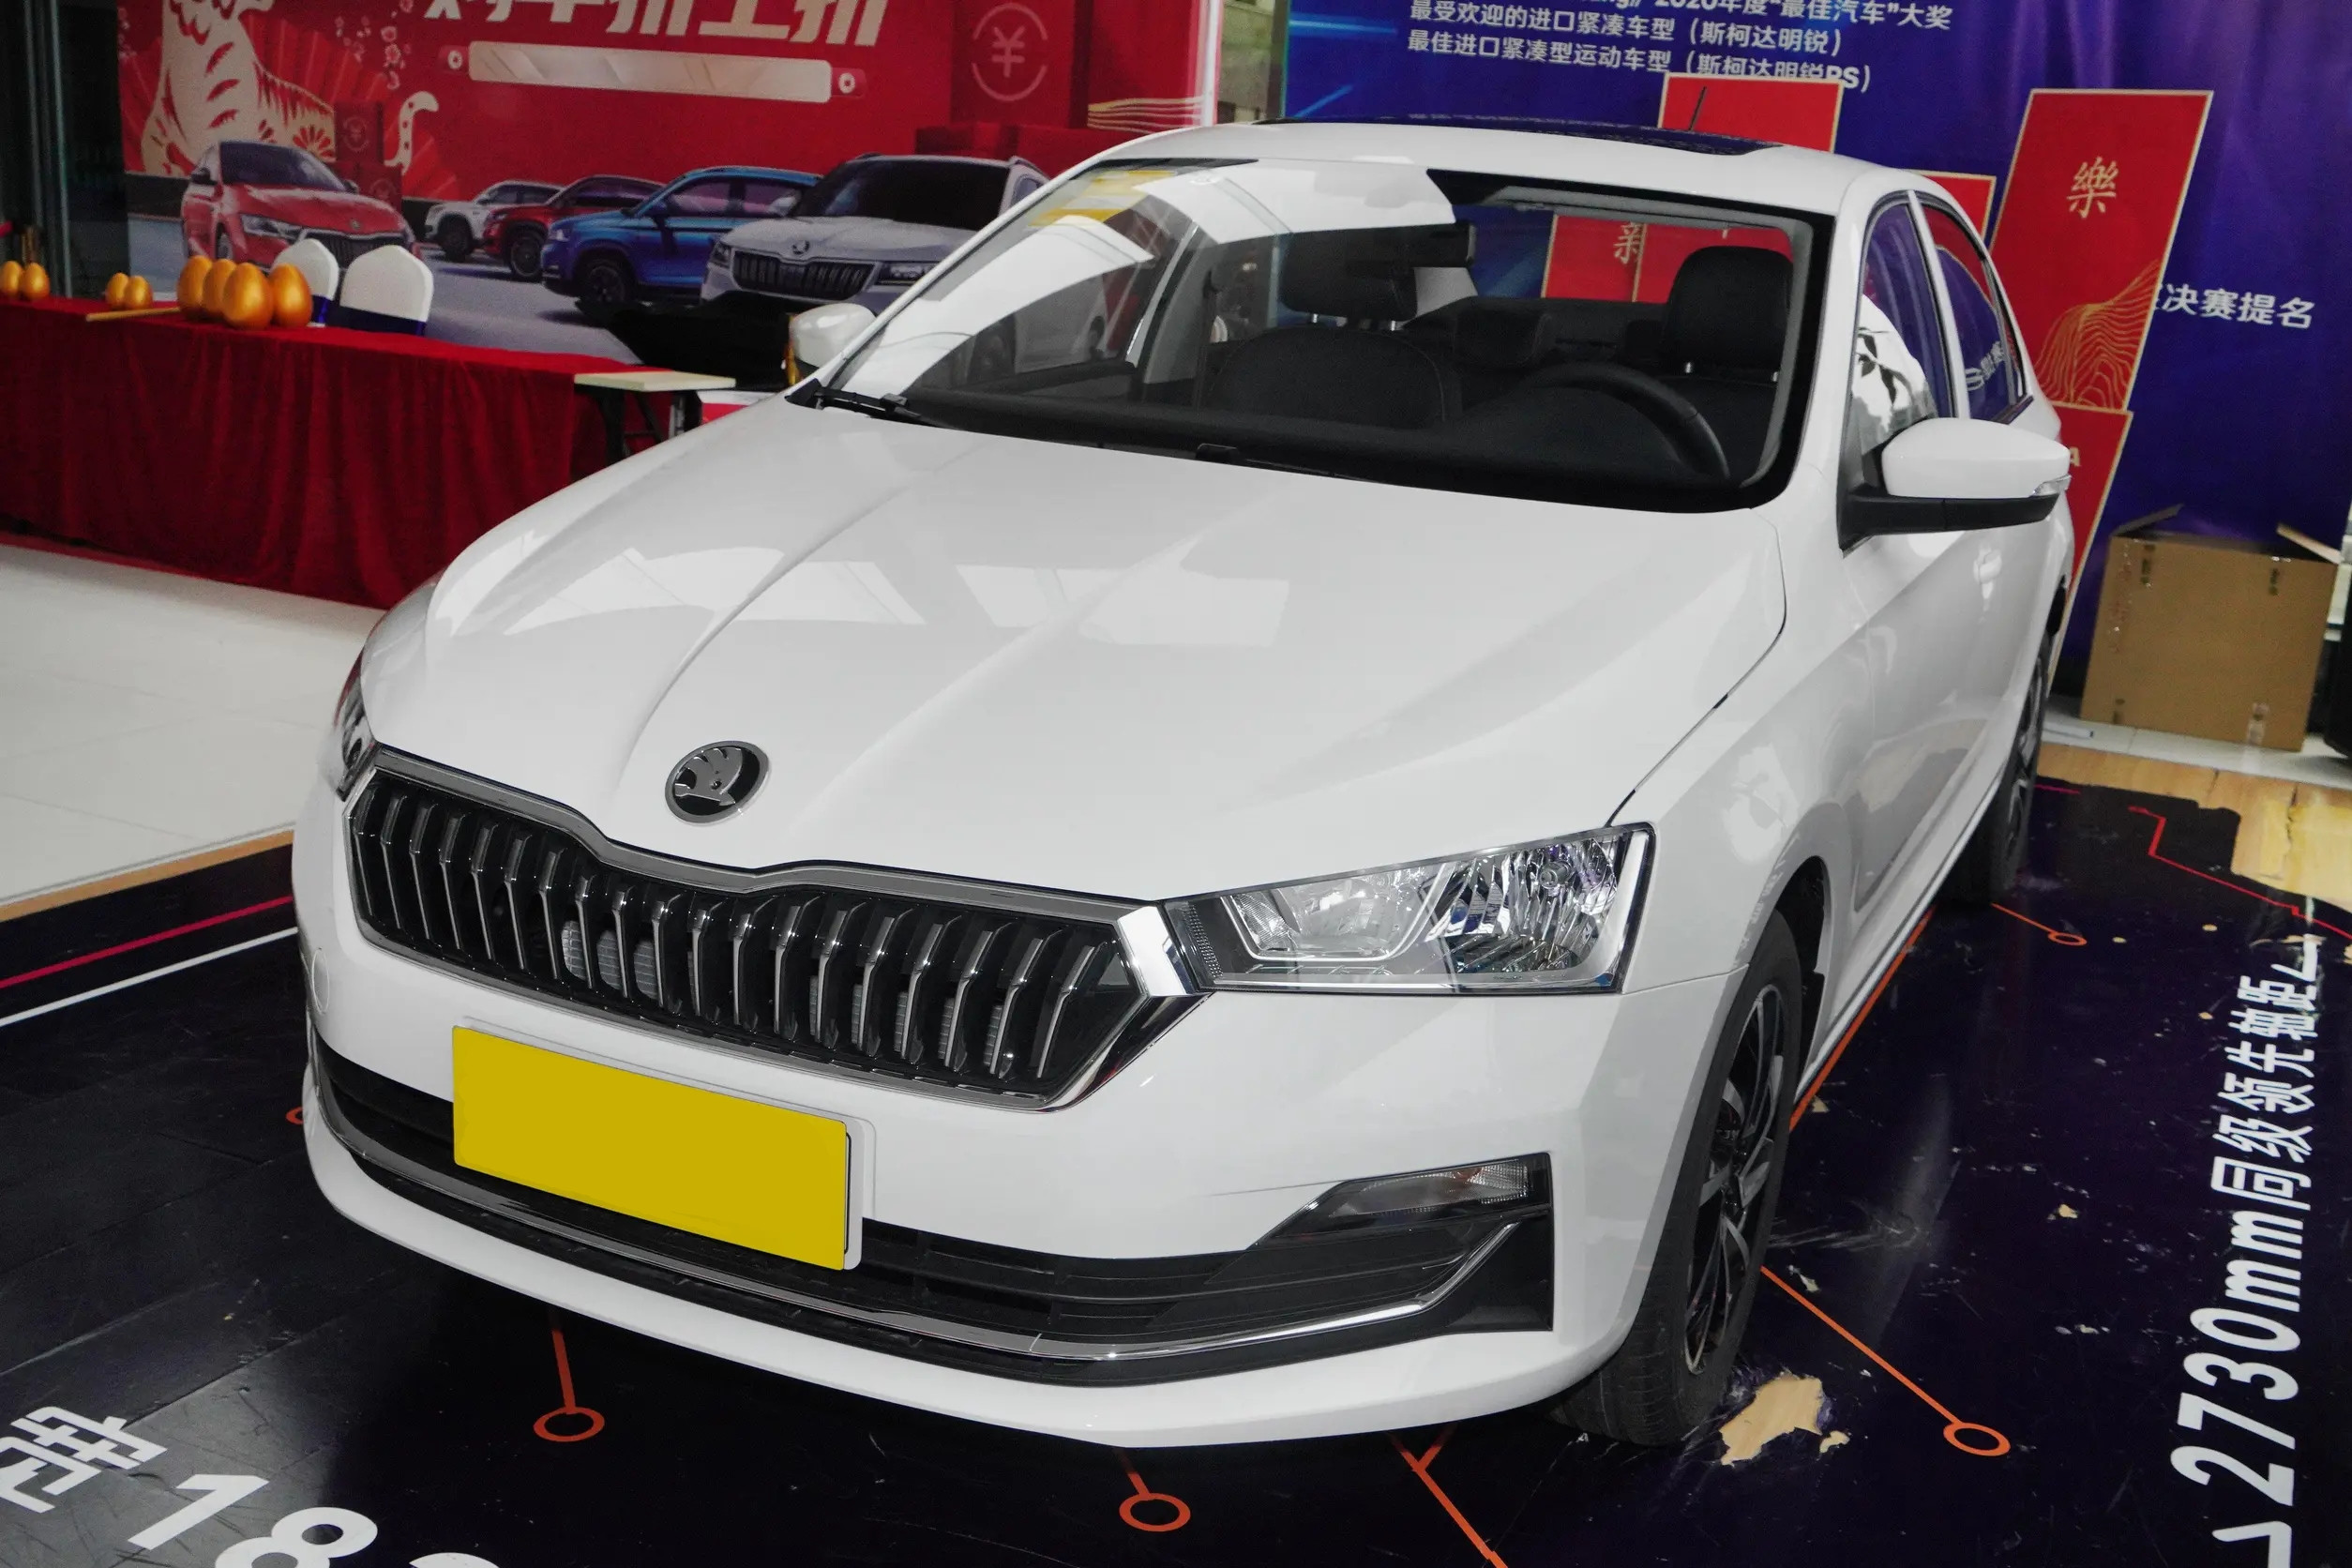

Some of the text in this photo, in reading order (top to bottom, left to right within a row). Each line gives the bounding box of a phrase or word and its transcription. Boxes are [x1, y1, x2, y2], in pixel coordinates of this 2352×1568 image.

[2066, 156, 2119, 218] 樂
[2155, 283, 2315, 329] 决赛提名
